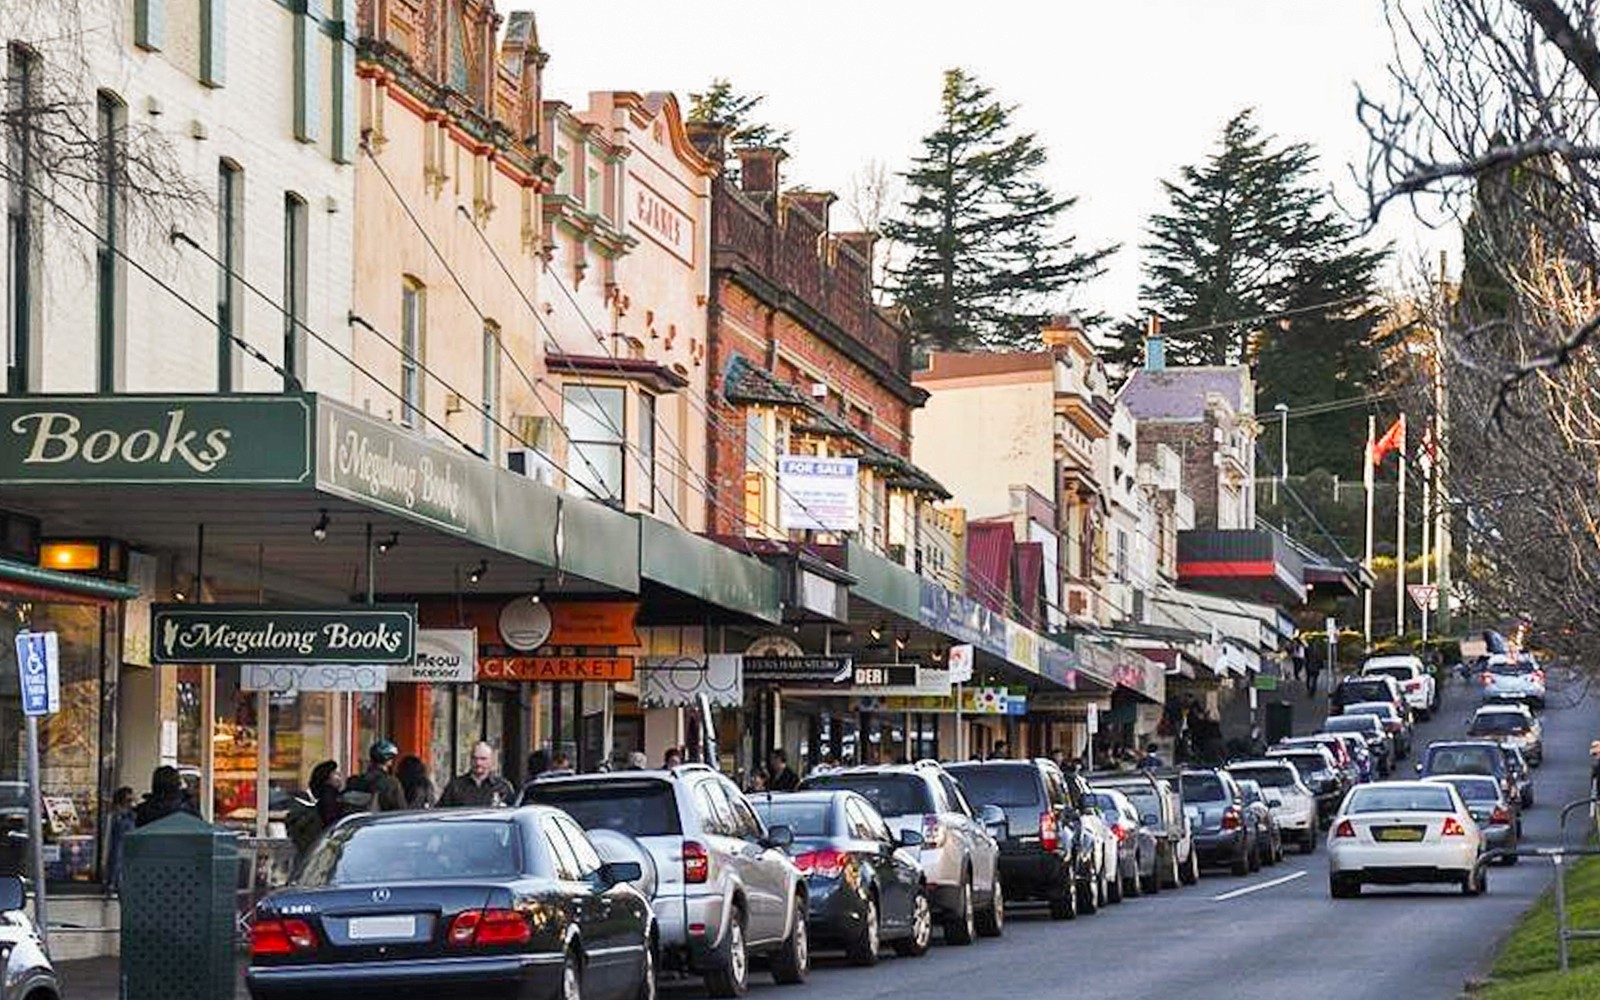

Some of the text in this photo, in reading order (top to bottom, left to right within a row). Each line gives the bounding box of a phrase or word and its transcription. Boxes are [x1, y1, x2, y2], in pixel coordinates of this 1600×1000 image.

[11, 409, 231, 473] Books
[338, 429, 459, 519] Megalong Books
[788, 461, 847, 477] FOR SALE
[179, 622, 403, 654] Megalong Books
